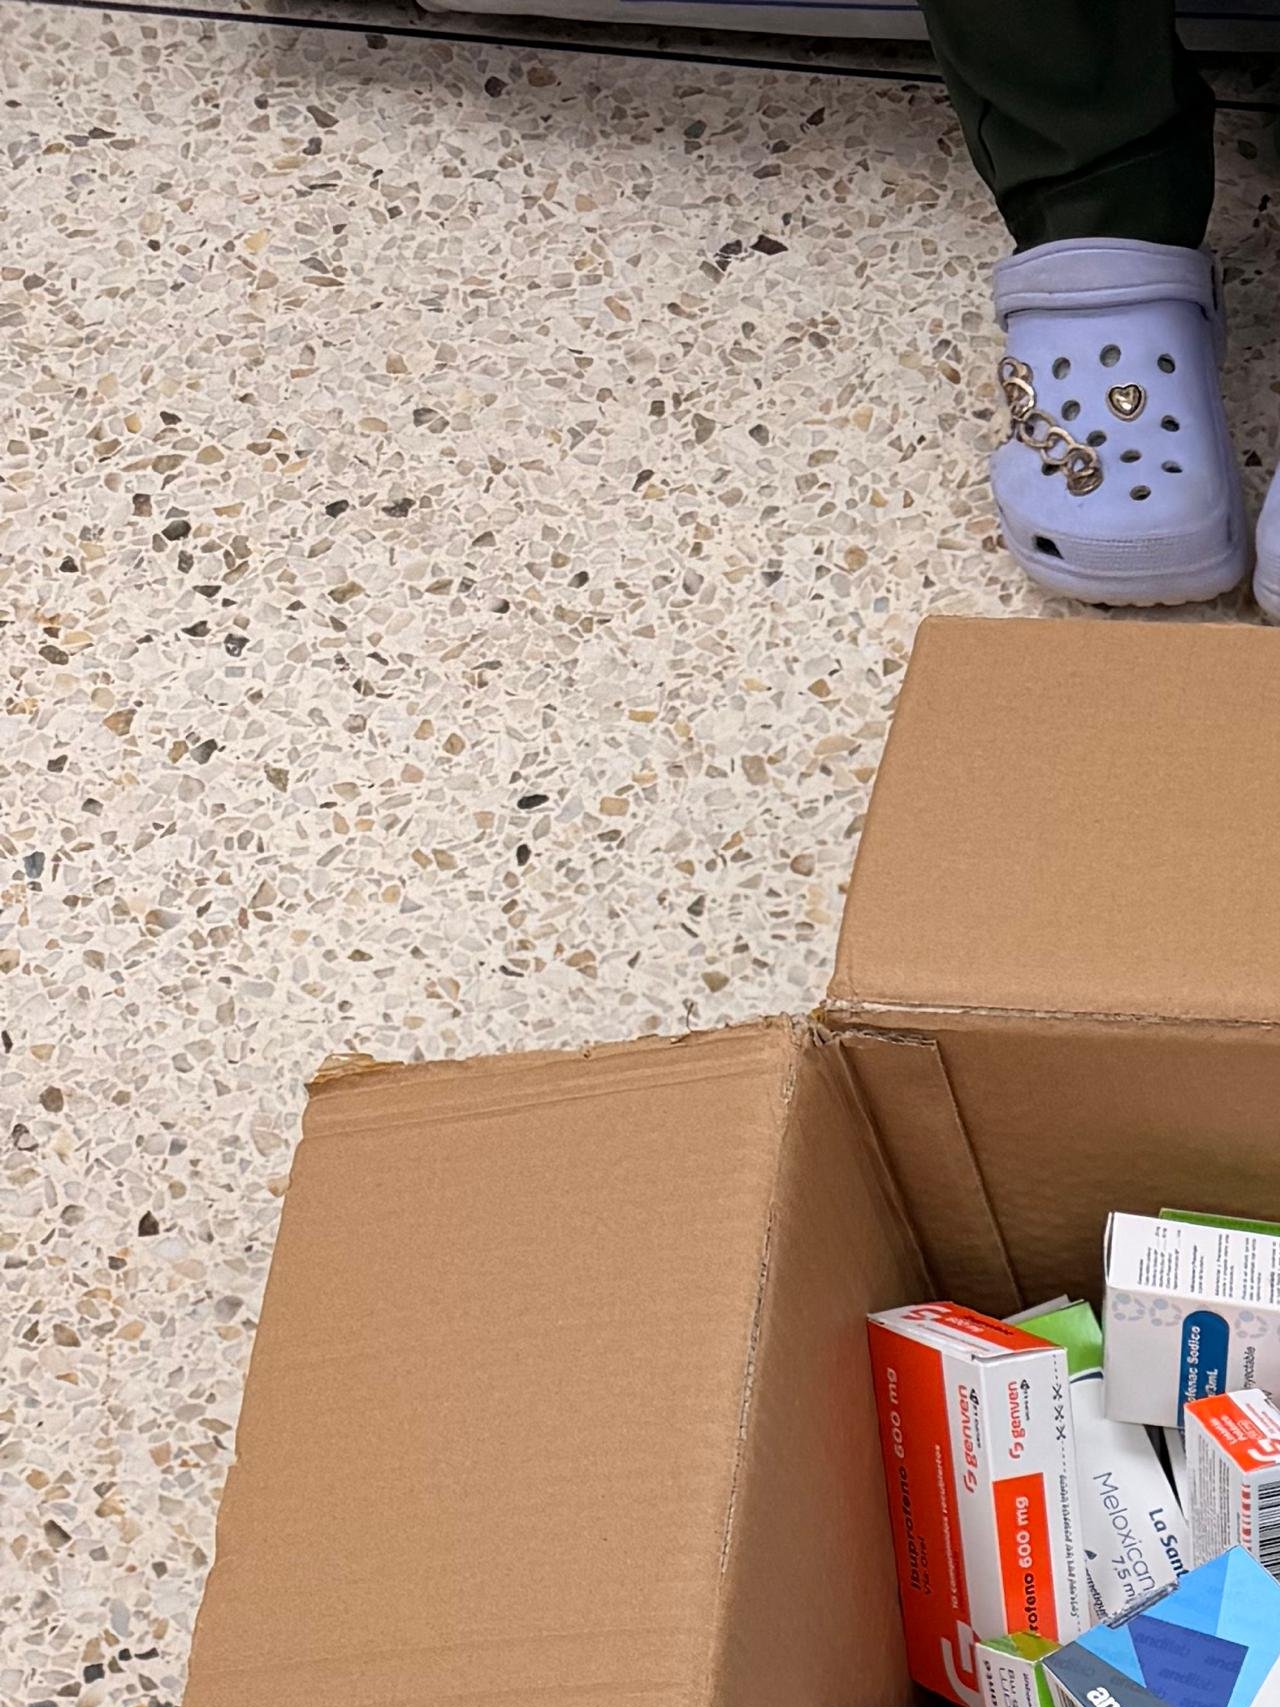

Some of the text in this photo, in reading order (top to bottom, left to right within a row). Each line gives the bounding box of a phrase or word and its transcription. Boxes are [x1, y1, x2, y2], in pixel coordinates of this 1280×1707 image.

[1009, 1381, 1025, 1439] genven
[1016, 1497, 1031, 1568] 600 mg
